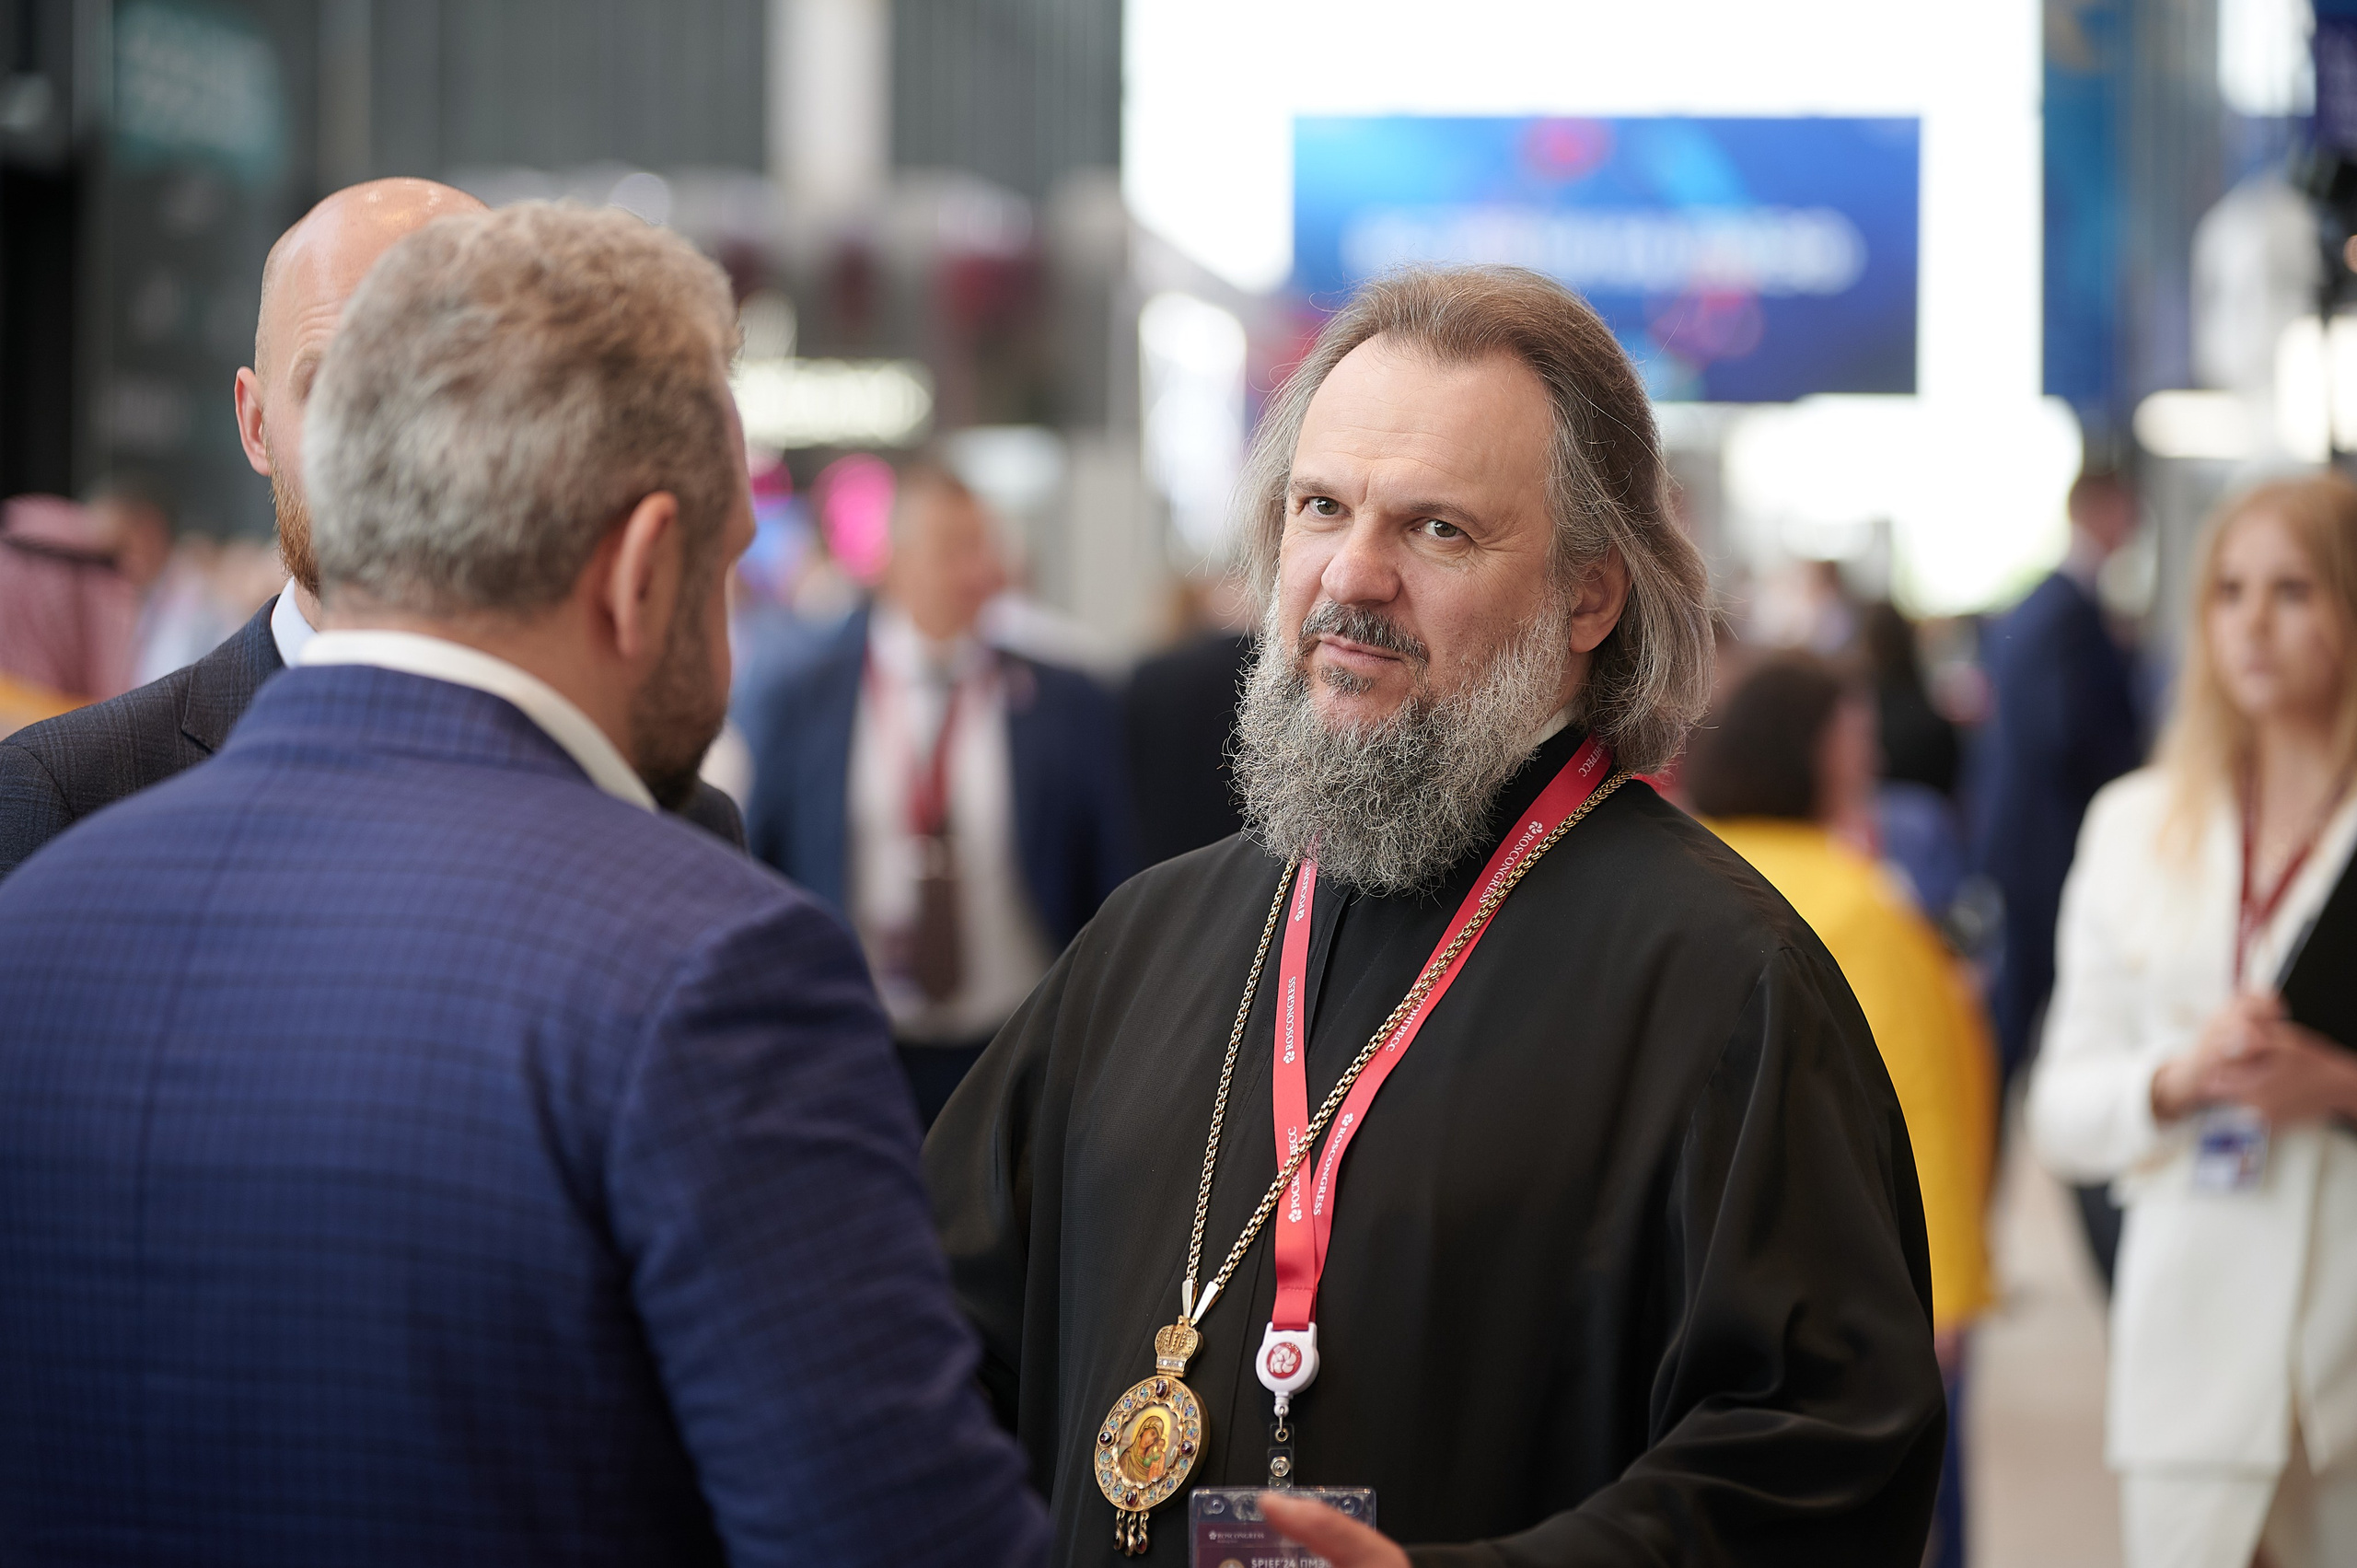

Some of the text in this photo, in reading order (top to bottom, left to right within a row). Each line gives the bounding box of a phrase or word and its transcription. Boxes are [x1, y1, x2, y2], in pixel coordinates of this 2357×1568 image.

[1479, 832, 1535, 904] ROSCONGRESS
[1285, 976, 1296, 1051] ROSCONGRESS
[1313, 1127, 1347, 1216] ROSCONGRESS
